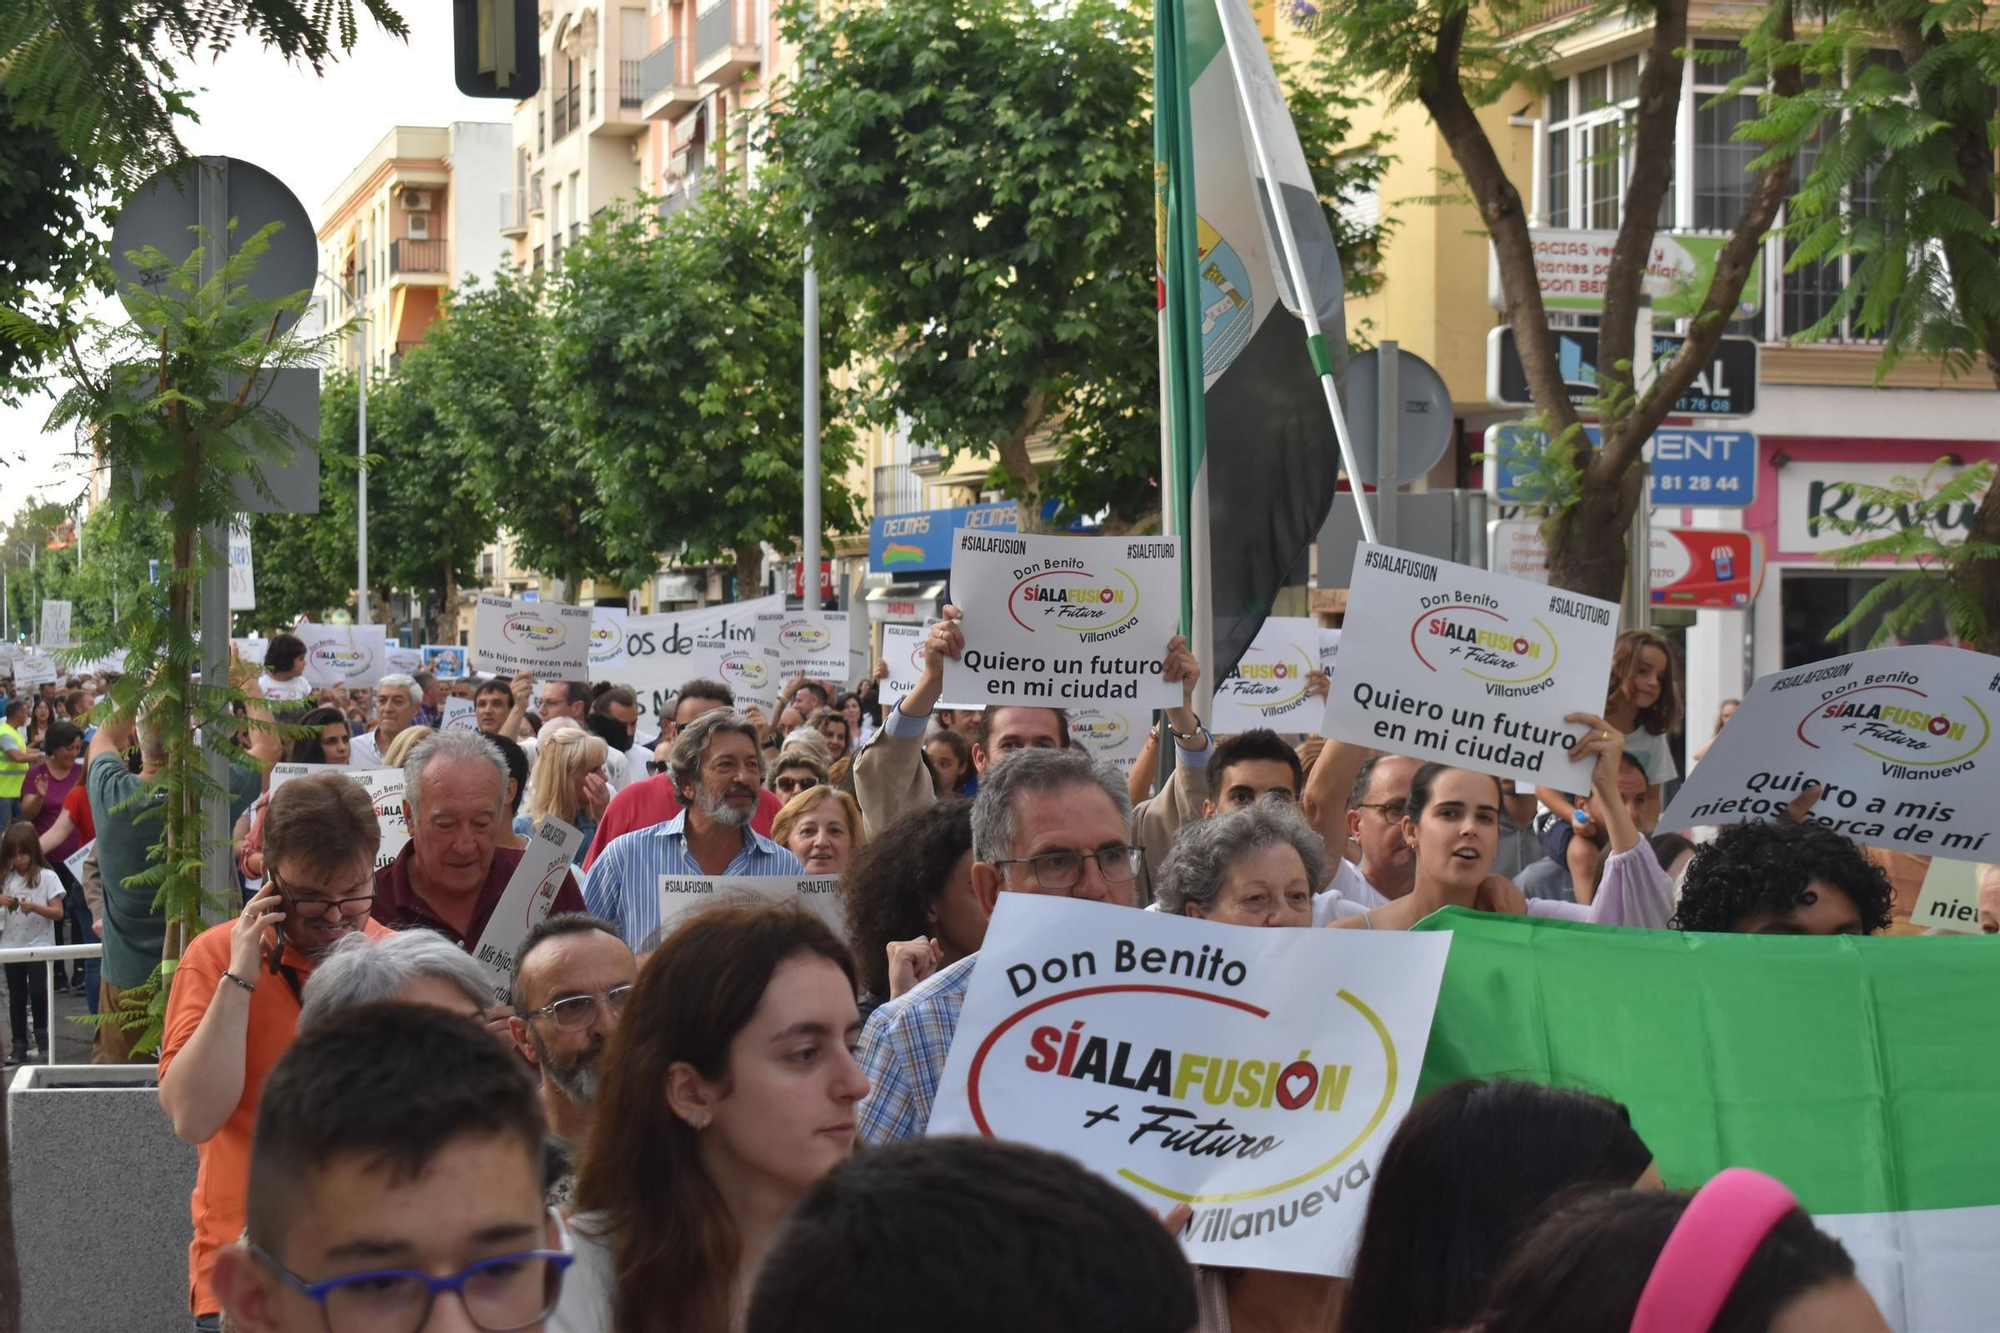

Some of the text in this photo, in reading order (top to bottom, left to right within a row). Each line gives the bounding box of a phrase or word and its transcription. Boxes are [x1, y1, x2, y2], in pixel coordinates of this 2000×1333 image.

[1690, 398, 1708, 411] 76
[1710, 399, 1731, 412] 08
[1661, 475, 1739, 491] 81 28 44
[882, 515, 931, 538] DECIMAS
[965, 505, 1019, 530] DECIMAS
[961, 535, 1175, 559] #SIALAFUSION #SIALFUTURO
[1013, 557, 1085, 581] Don Benito
[1364, 550, 1610, 627] #SIALAFUSION #SIALFUTURO
[1420, 590, 1499, 610] Don Benito
[481, 597, 513, 609] #SIALAFUSION
[1058, 605, 1107, 619] Futuro
[888, 627, 920, 638] #SIALAFUSION
[1079, 615, 1139, 643] Villanueva
[479, 649, 583, 668] Mis hijos merecen más
[795, 659, 828, 667] merecen
[829, 658, 846, 668] más
[963, 649, 1163, 675] Quiero un futuro
[1463, 646, 1519, 670] Futuro
[495, 665, 563, 679] oportidades
[1769, 662, 1854, 693] #SIALAFUSION
[986, 677, 1138, 699] en mi ciudad
[1232, 681, 1282, 696] Futuro
[1485, 676, 1555, 698] Villanueva
[1821, 672, 1919, 701] Don Benito
[1353, 682, 1577, 751] Quiero un futuro
[1373, 719, 1545, 772] en mi ciudad
[1858, 721, 1932, 751] Futuro
[275, 766, 309, 775] #SIALAFUSION
[1881, 759, 1976, 781] Villanueva
[383, 782, 404, 793] Benit
[1865, 797, 1886, 814] a
[1895, 800, 1956, 823] mis
[1892, 822, 1934, 844] de
[1940, 831, 1992, 852] mí
[664, 881, 714, 894] #SIALAFUSION
[477, 943, 496, 963] Mis
[1005, 938, 1248, 998] Don Benito
[1128, 1104, 1284, 1161] Futuro
[1183, 1157, 1373, 1244] Villanueva
